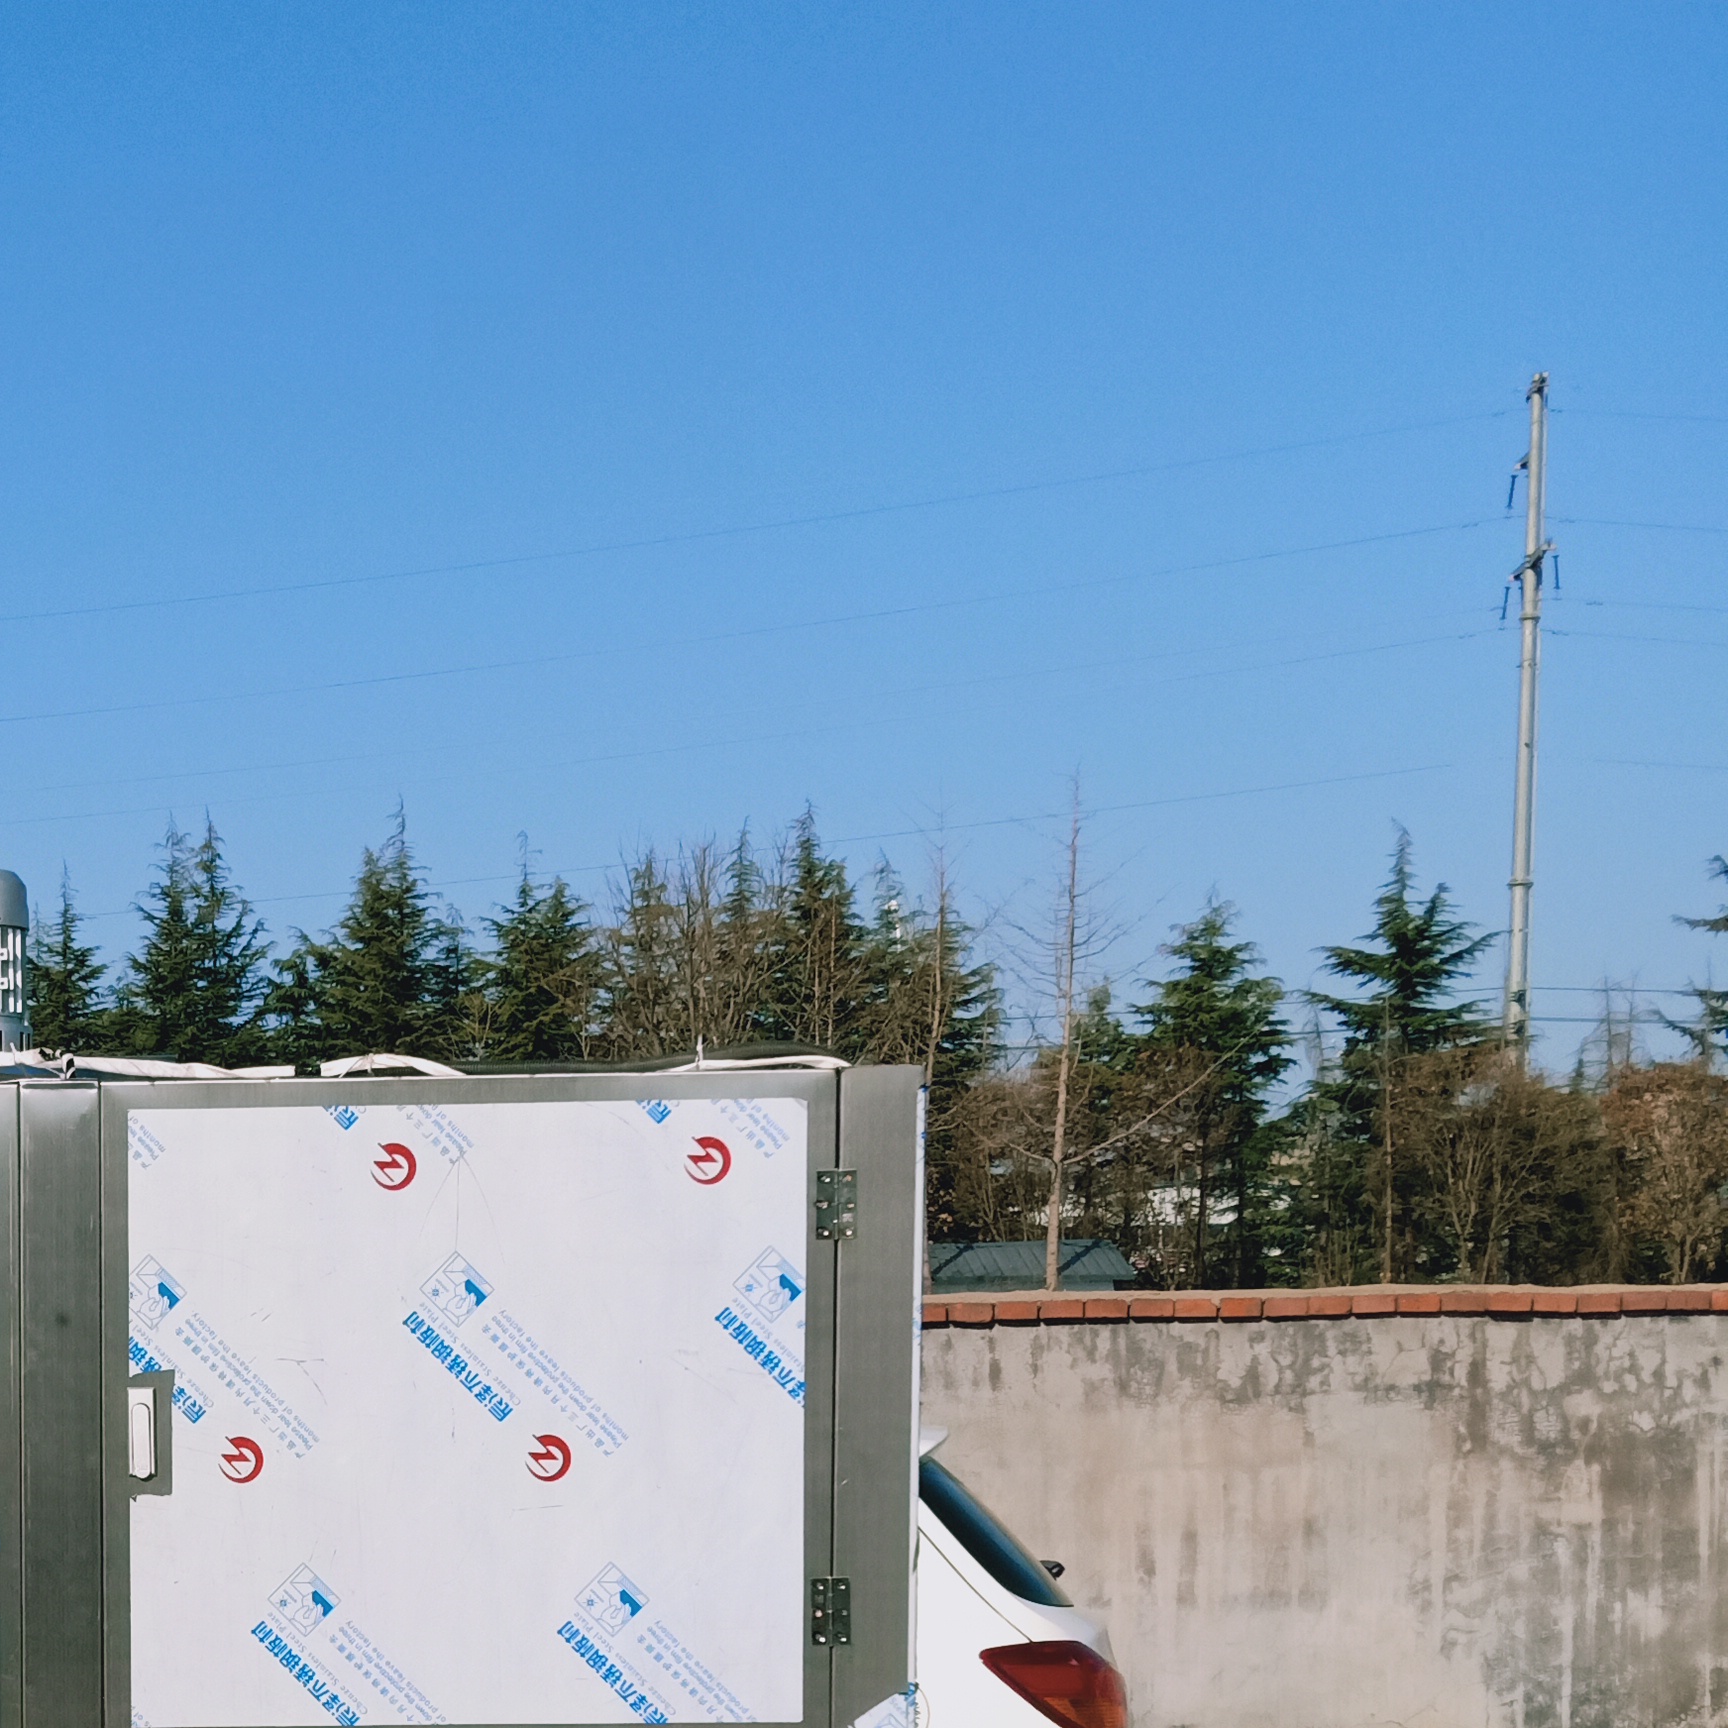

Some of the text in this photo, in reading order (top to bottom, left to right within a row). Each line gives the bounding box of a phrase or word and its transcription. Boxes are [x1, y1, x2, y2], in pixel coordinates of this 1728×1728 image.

[401, 1310, 513, 1421] 辰泽不锈钢板材
[250, 1619, 360, 1725] 辰泽不锈钢板材
[556, 1620, 668, 1725] 辰泽不锈钢板材
